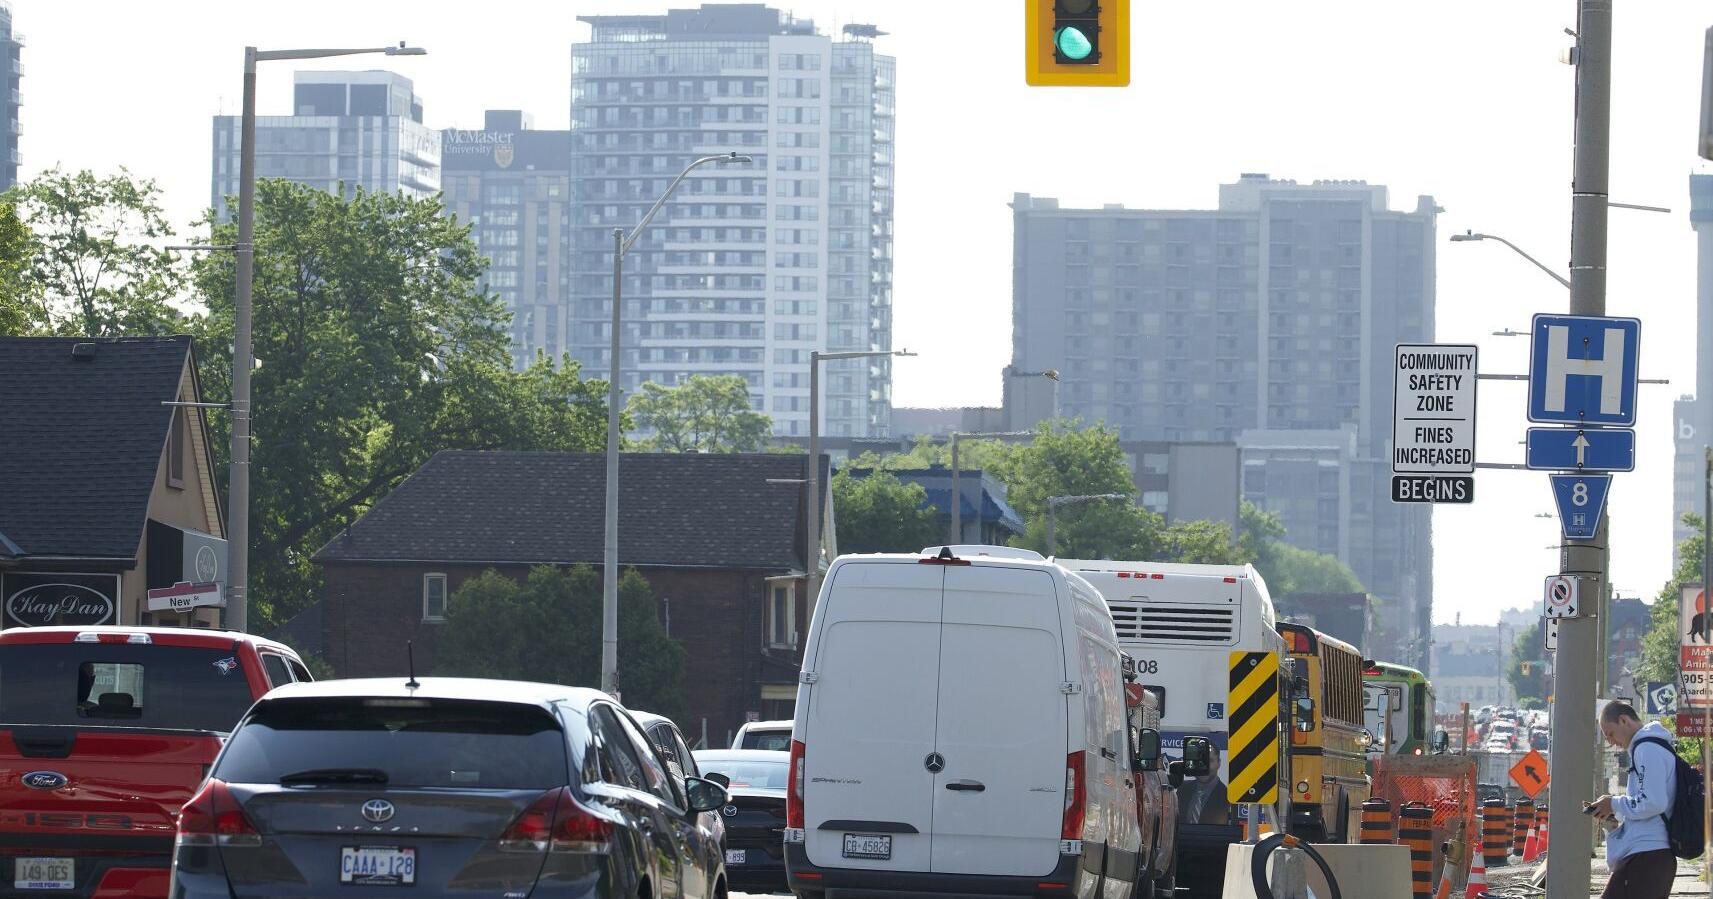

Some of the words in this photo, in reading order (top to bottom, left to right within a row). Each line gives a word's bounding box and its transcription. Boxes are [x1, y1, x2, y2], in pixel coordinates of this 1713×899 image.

[447, 128, 514, 144] McMaster
[444, 144, 493, 156] University
[1400, 353, 1473, 370] COMMUNITY
[1544, 325, 1625, 415] H
[1409, 374, 1462, 391] SAFETY
[1416, 395, 1454, 412] ZONE
[1415, 427, 1453, 443] FINES
[1396, 448, 1471, 465] INCREASED
[1399, 479, 1466, 500] BEGINS
[1572, 482, 1588, 507] 8
[13, 594, 105, 622] KayDan
[169, 597, 191, 607] New
[32, 774, 57, 785] Ford
